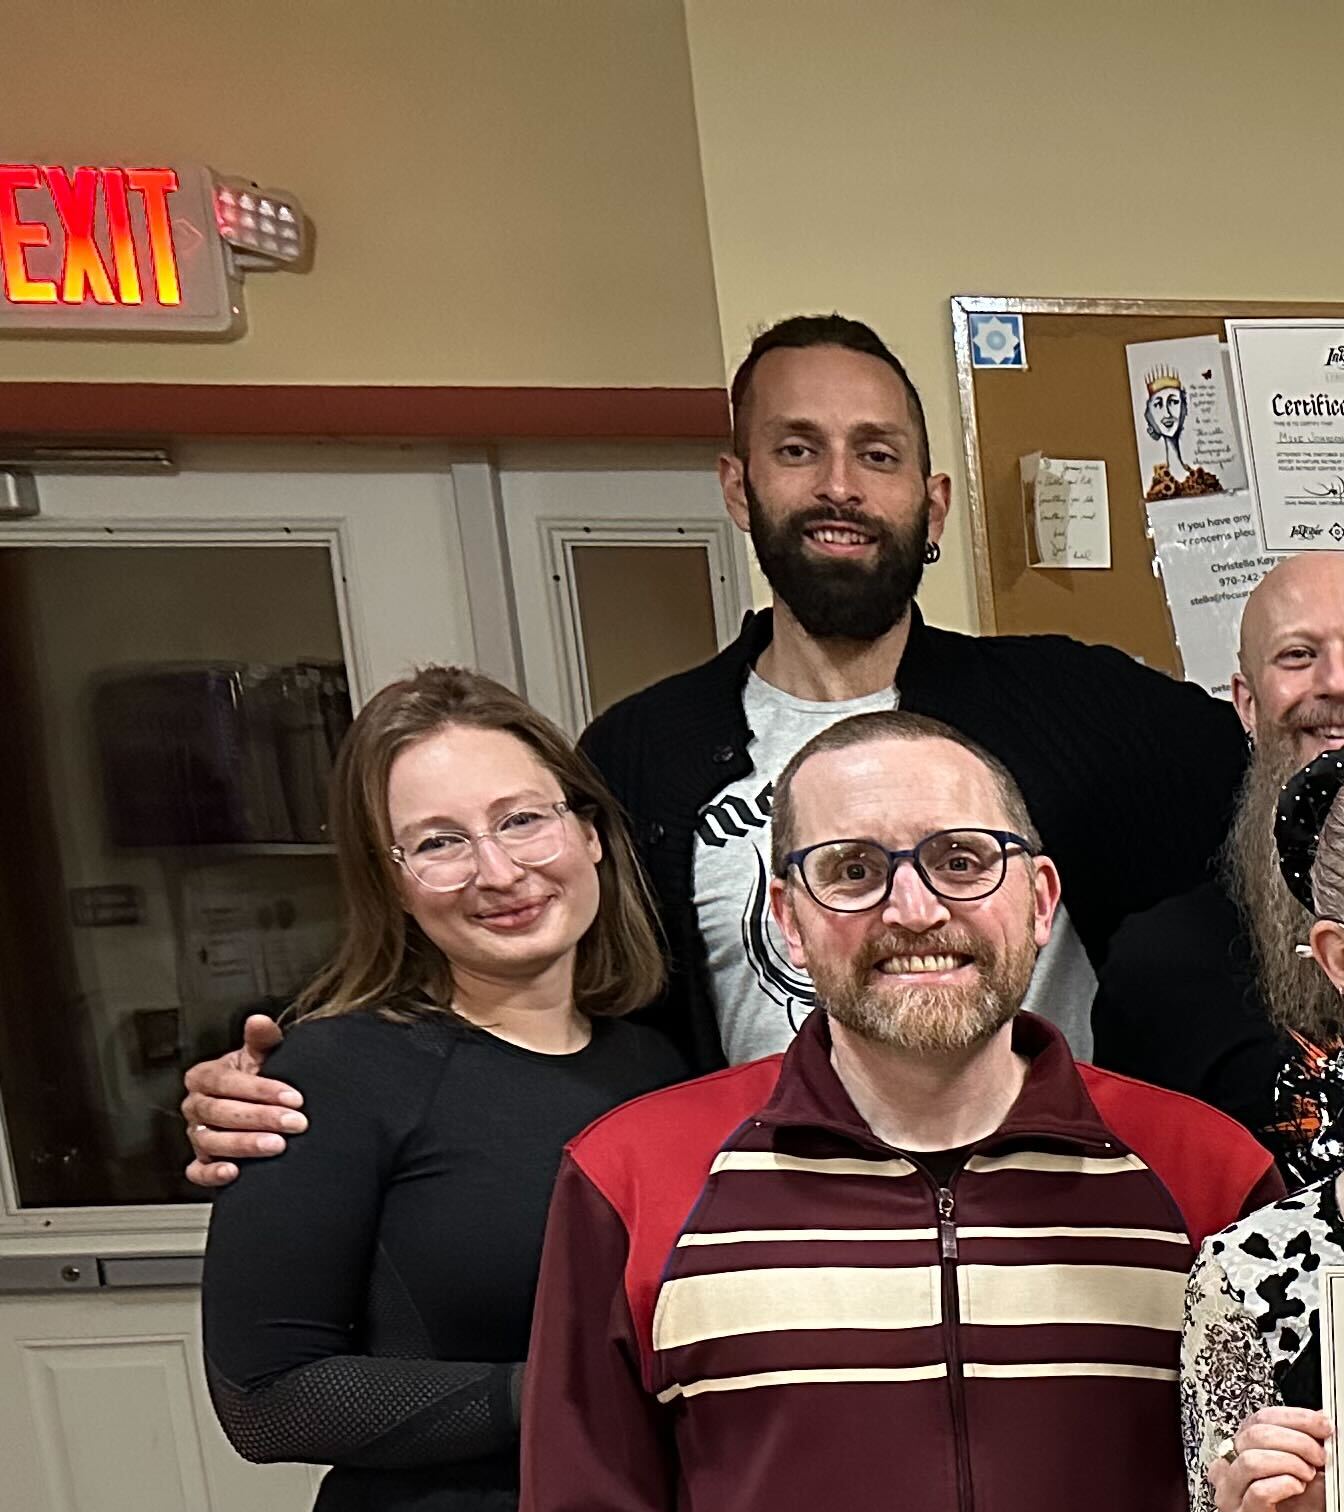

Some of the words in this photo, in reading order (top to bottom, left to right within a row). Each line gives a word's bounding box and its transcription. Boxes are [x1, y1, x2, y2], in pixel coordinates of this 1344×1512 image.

[0, 164, 181, 306] EXIT
[1178, 523, 1186, 532] If
[1187, 521, 1206, 533] you
[1207, 517, 1231, 528] have
[1232, 513, 1251, 526] any
[1210, 559, 1256, 573] Christella
[1257, 556, 1276, 567] Kay
